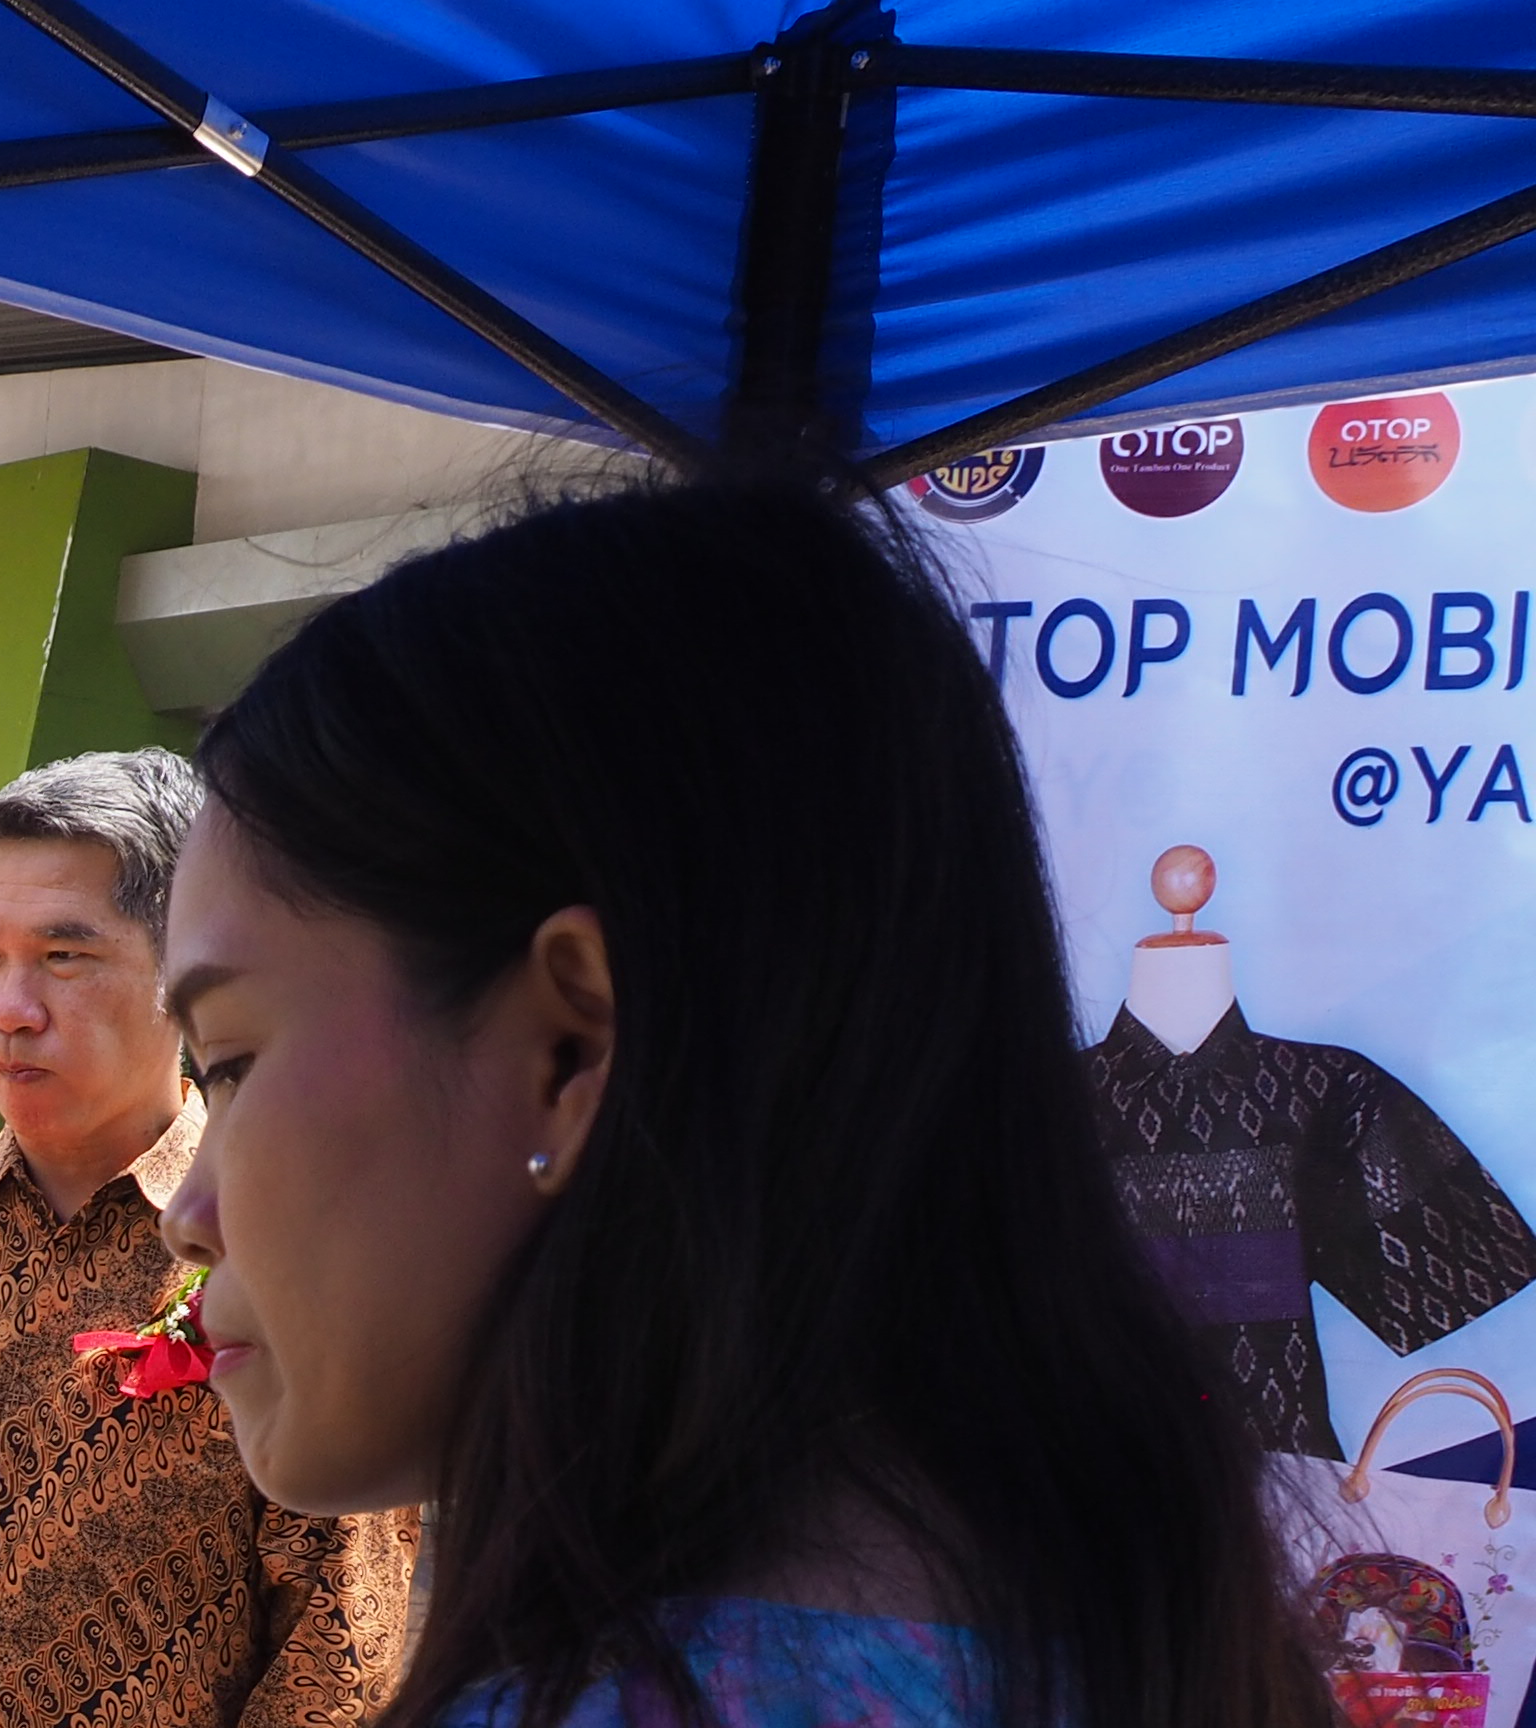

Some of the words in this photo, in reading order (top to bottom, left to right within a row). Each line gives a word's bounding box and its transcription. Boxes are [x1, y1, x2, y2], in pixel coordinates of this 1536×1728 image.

[1112, 425, 1233, 458] OTOP
[1341, 418, 1431, 442] OTOP
[1230, 591, 1530, 698] MOBI
[1332, 744, 1533, 827] @YA
